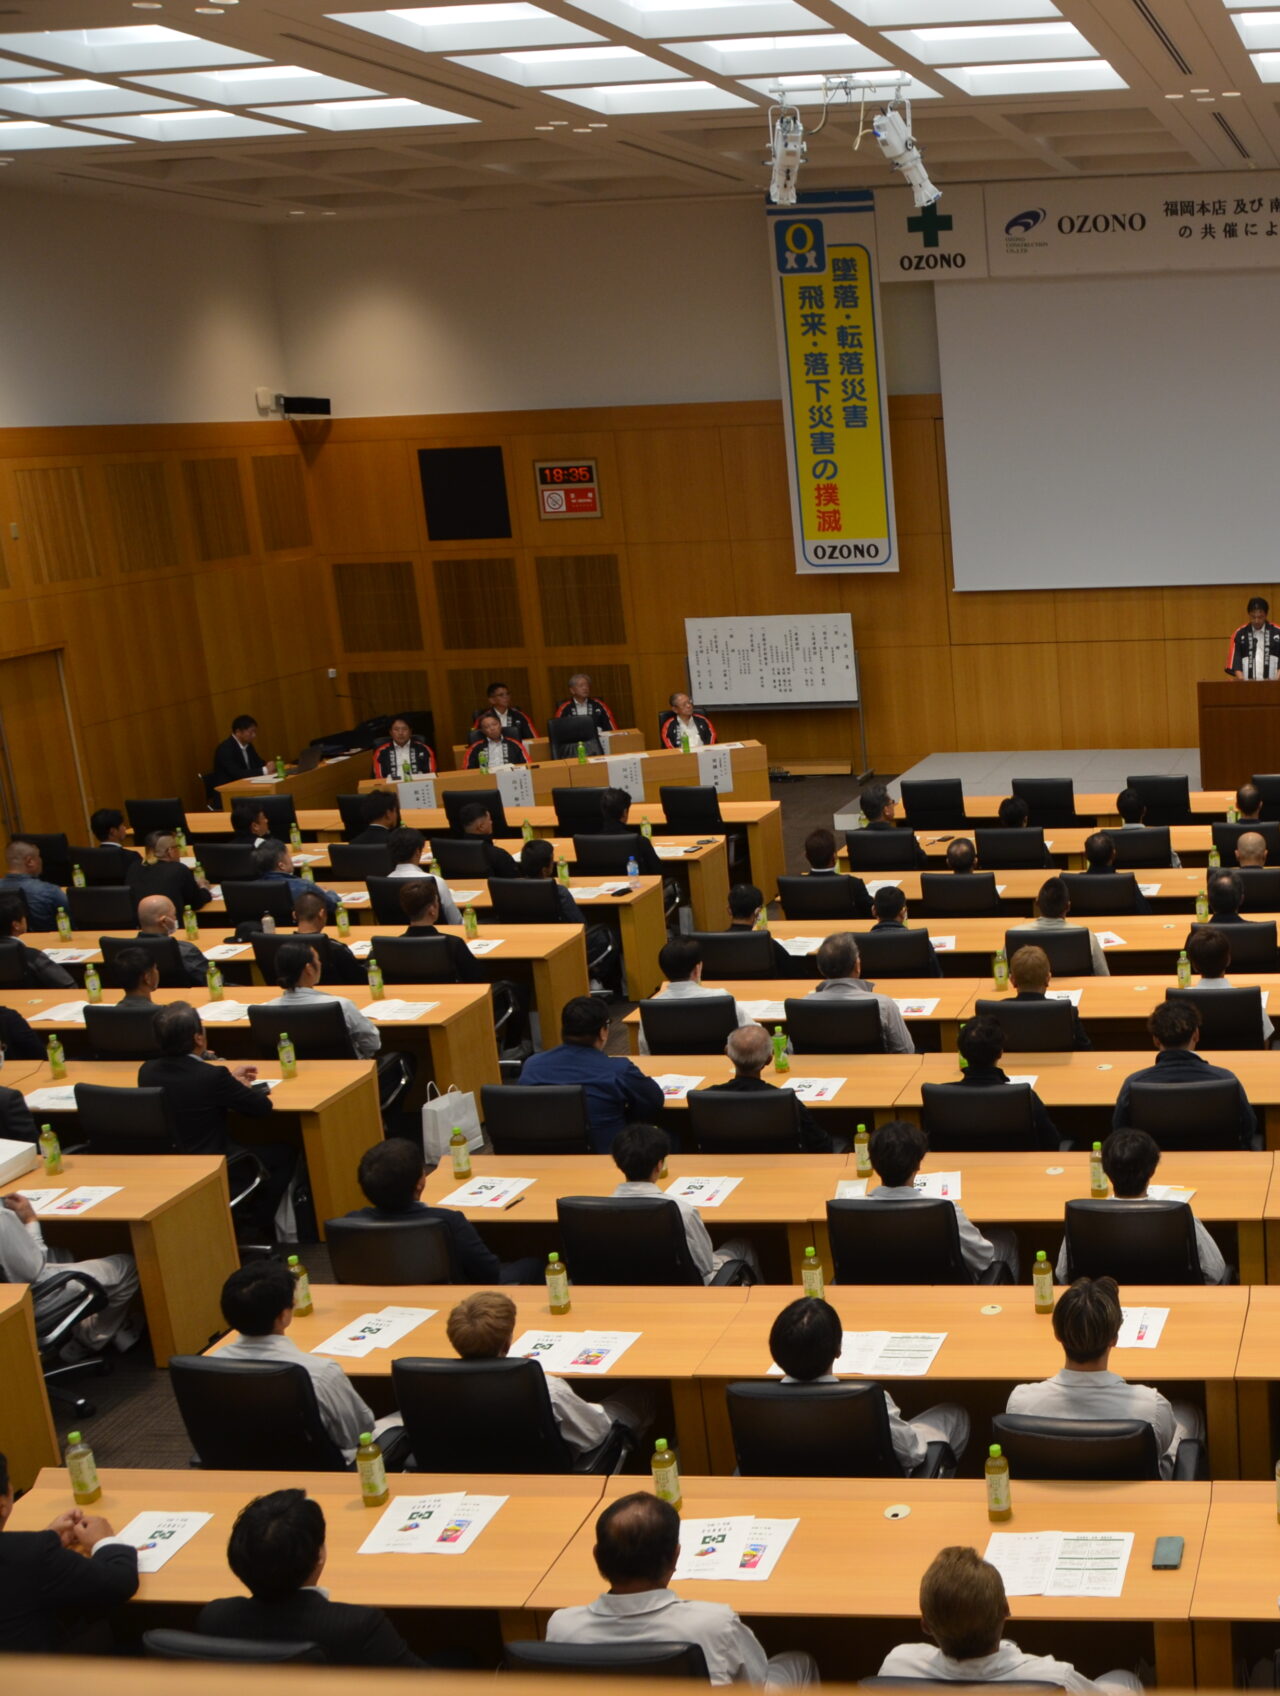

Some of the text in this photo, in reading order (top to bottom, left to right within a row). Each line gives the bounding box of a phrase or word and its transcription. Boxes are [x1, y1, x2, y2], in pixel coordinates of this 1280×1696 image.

[1162, 199, 1228, 217] 福岡本店
[1233, 197, 1264, 215] 及び
[1057, 212, 1147, 235] OZONO
[899, 252, 967, 271] OZONO
[831, 257, 869, 429] 墜落・転落災害
[798, 285, 843, 533] 飛来・落下災害の撲滅
[543, 466, 591, 483] 18:35
[813, 543, 880, 560] OZONO
